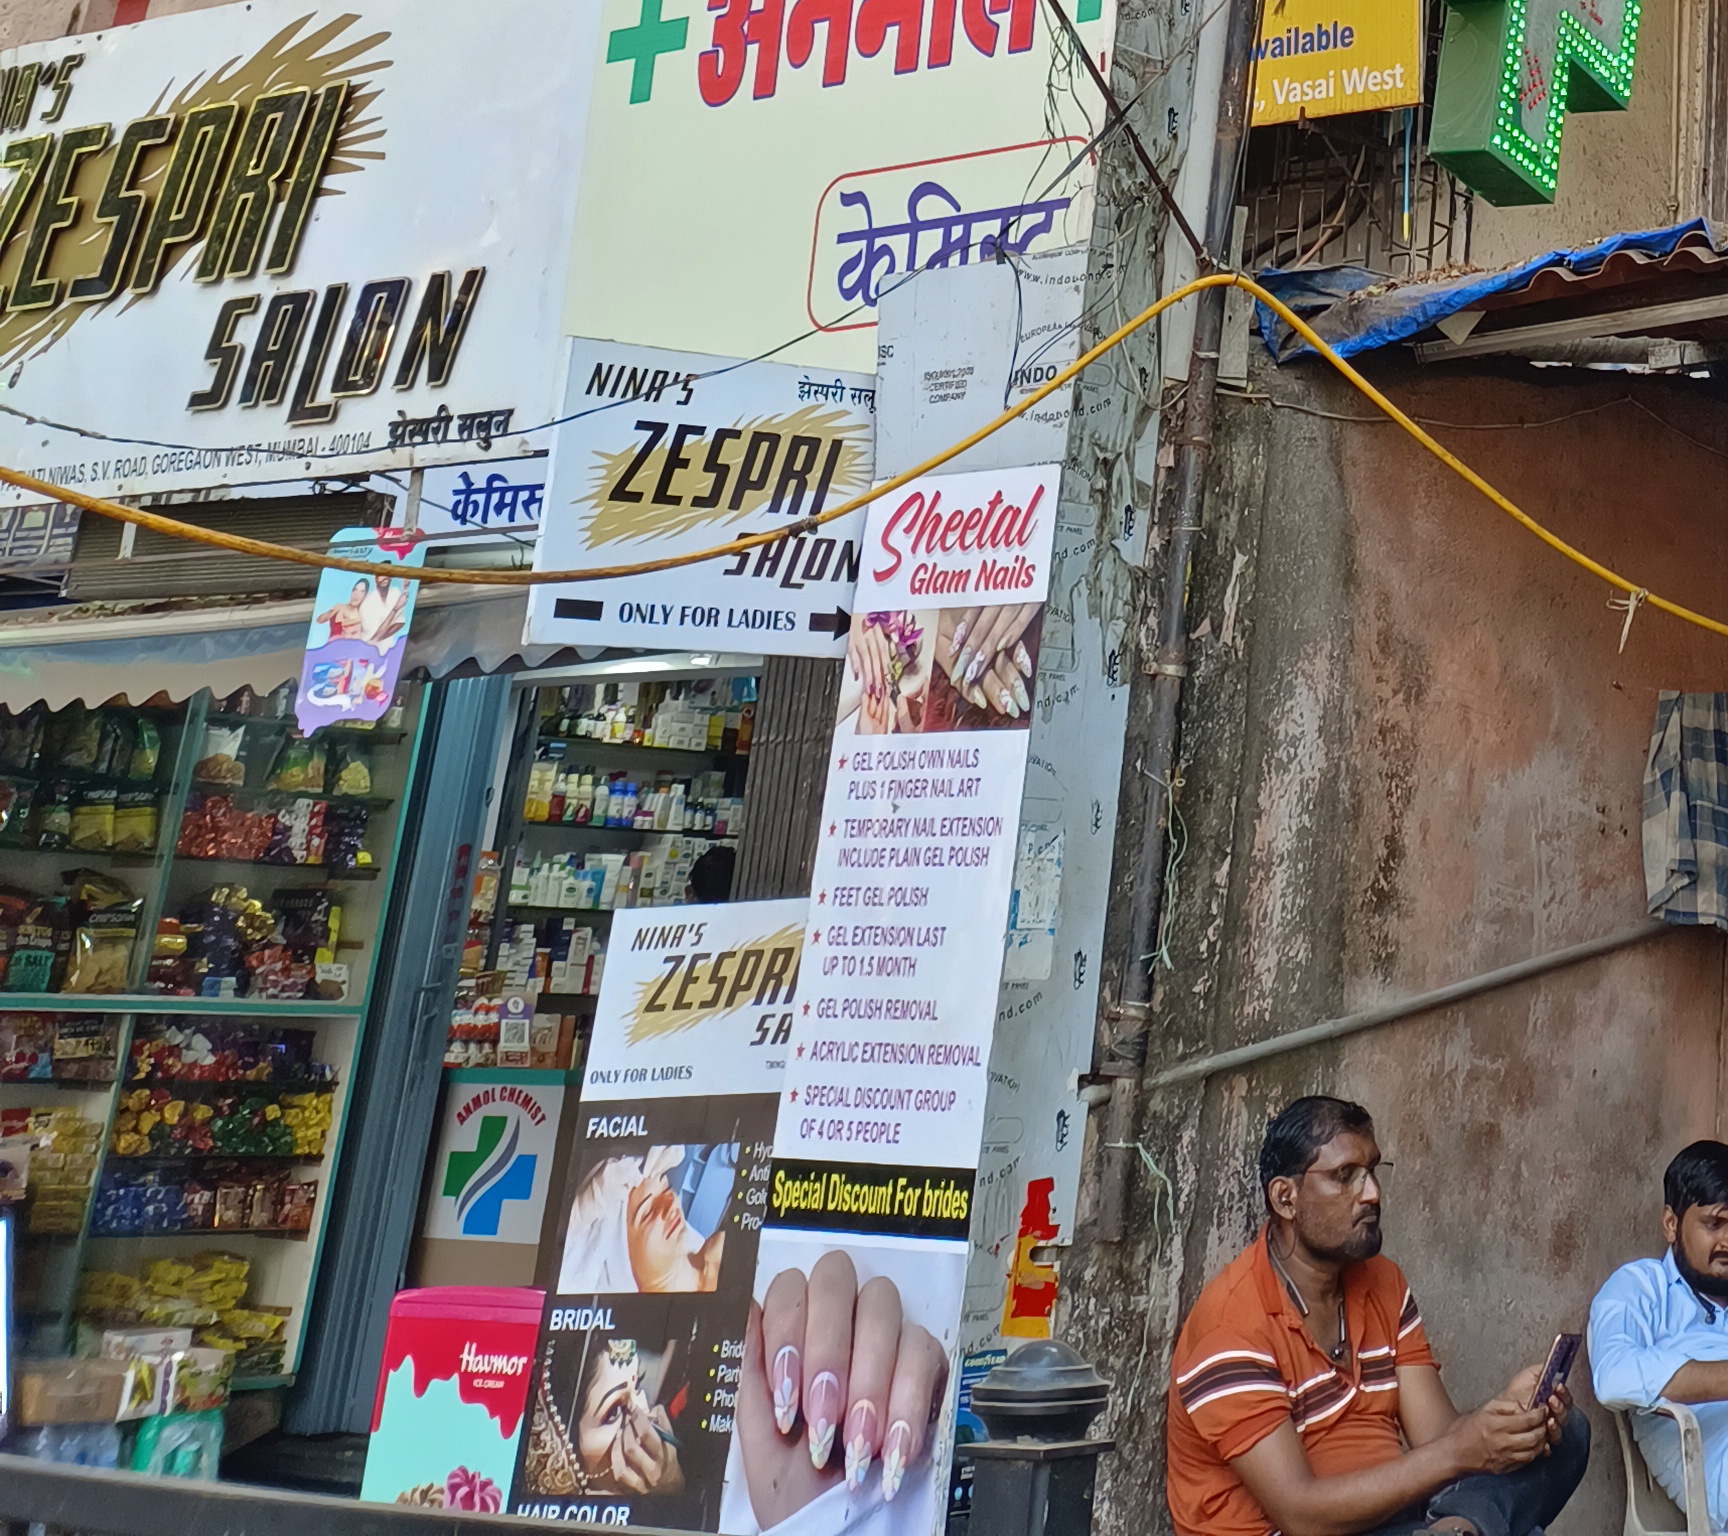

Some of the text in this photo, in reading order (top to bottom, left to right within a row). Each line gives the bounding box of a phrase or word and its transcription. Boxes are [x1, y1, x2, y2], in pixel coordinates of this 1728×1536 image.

[1272, 62, 1405, 106] Vasai West
[0, 80, 352, 314] ZESPRI
[186, 266, 486, 427] SALON
[152, 431, 371, 474] GOREGAON 400104
[608, 419, 844, 516] ZESPRI
[873, 482, 1046, 584] Sheetal
[909, 555, 1037, 596] Glam Nails
[618, 602, 797, 632] ONLY FOR LADIES
[852, 749, 917, 772] GEL POLISH
[843, 817, 912, 840] TEMPORARY
[631, 921, 709, 952] NINA'S
[810, 1040, 982, 1067] ACRYLIC REMOVAL
[589, 1068, 621, 1085] ONLY
[455, 1085, 547, 1127] ANMOL CHEMIST
[914, 1089, 957, 1113] GROUP
[586, 1114, 649, 1140] FACIAL
[855, 1120, 902, 1144] PEOPLE
[772, 1169, 970, 1220] Special Discount brides
[550, 1307, 616, 1331] BRIDAL
[460, 1340, 529, 1378] Havmor
[563, 1505, 632, 1528] COLOR
